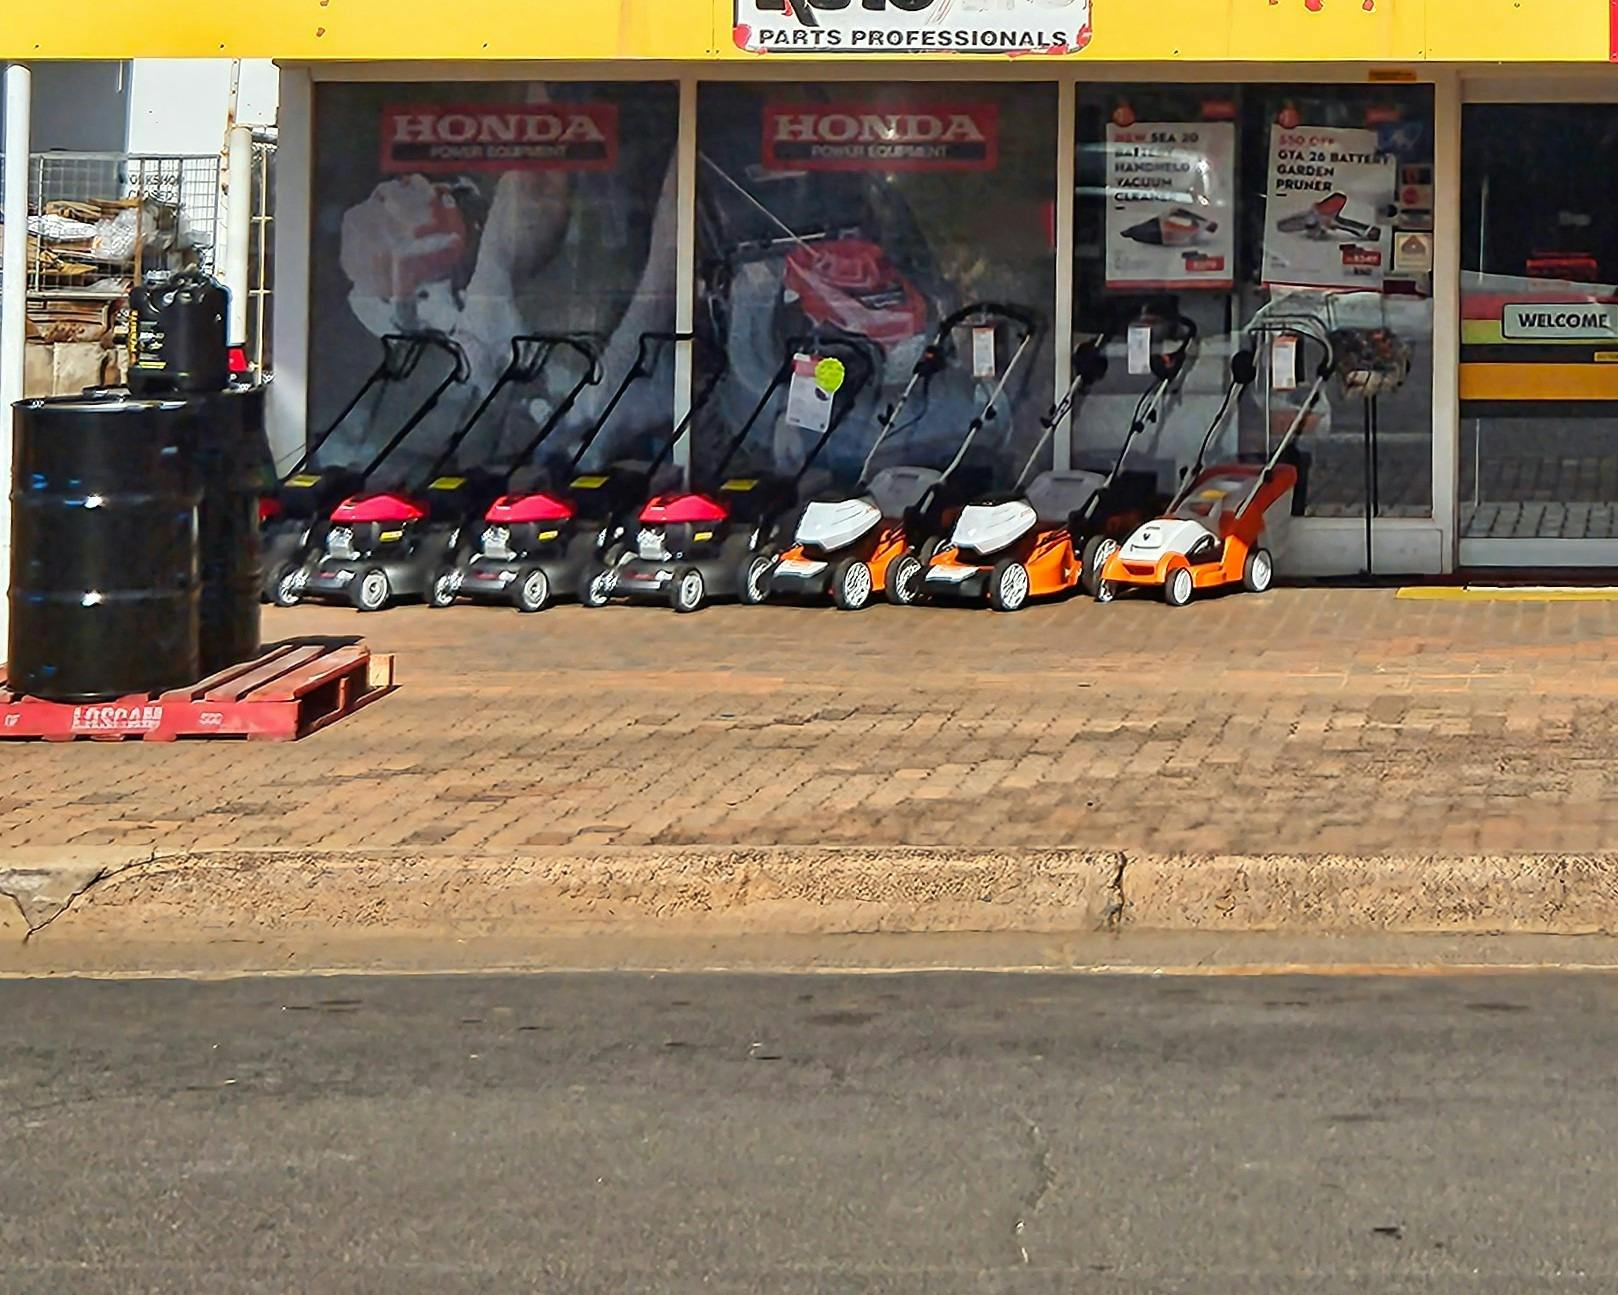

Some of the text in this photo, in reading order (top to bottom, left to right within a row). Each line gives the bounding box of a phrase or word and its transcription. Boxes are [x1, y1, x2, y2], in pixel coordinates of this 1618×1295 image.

[759, 29, 1067, 47] PARTS PROFESSIONALS
[393, 114, 605, 141] HONDA
[774, 114, 985, 141] HONDA
[1151, 132, 1176, 143] SEA
[1276, 164, 1335, 177] GARDEN
[1116, 177, 1172, 188] VACUUM
[1275, 178, 1333, 192] PRUNER
[1518, 312, 1608, 328] WELCOME
